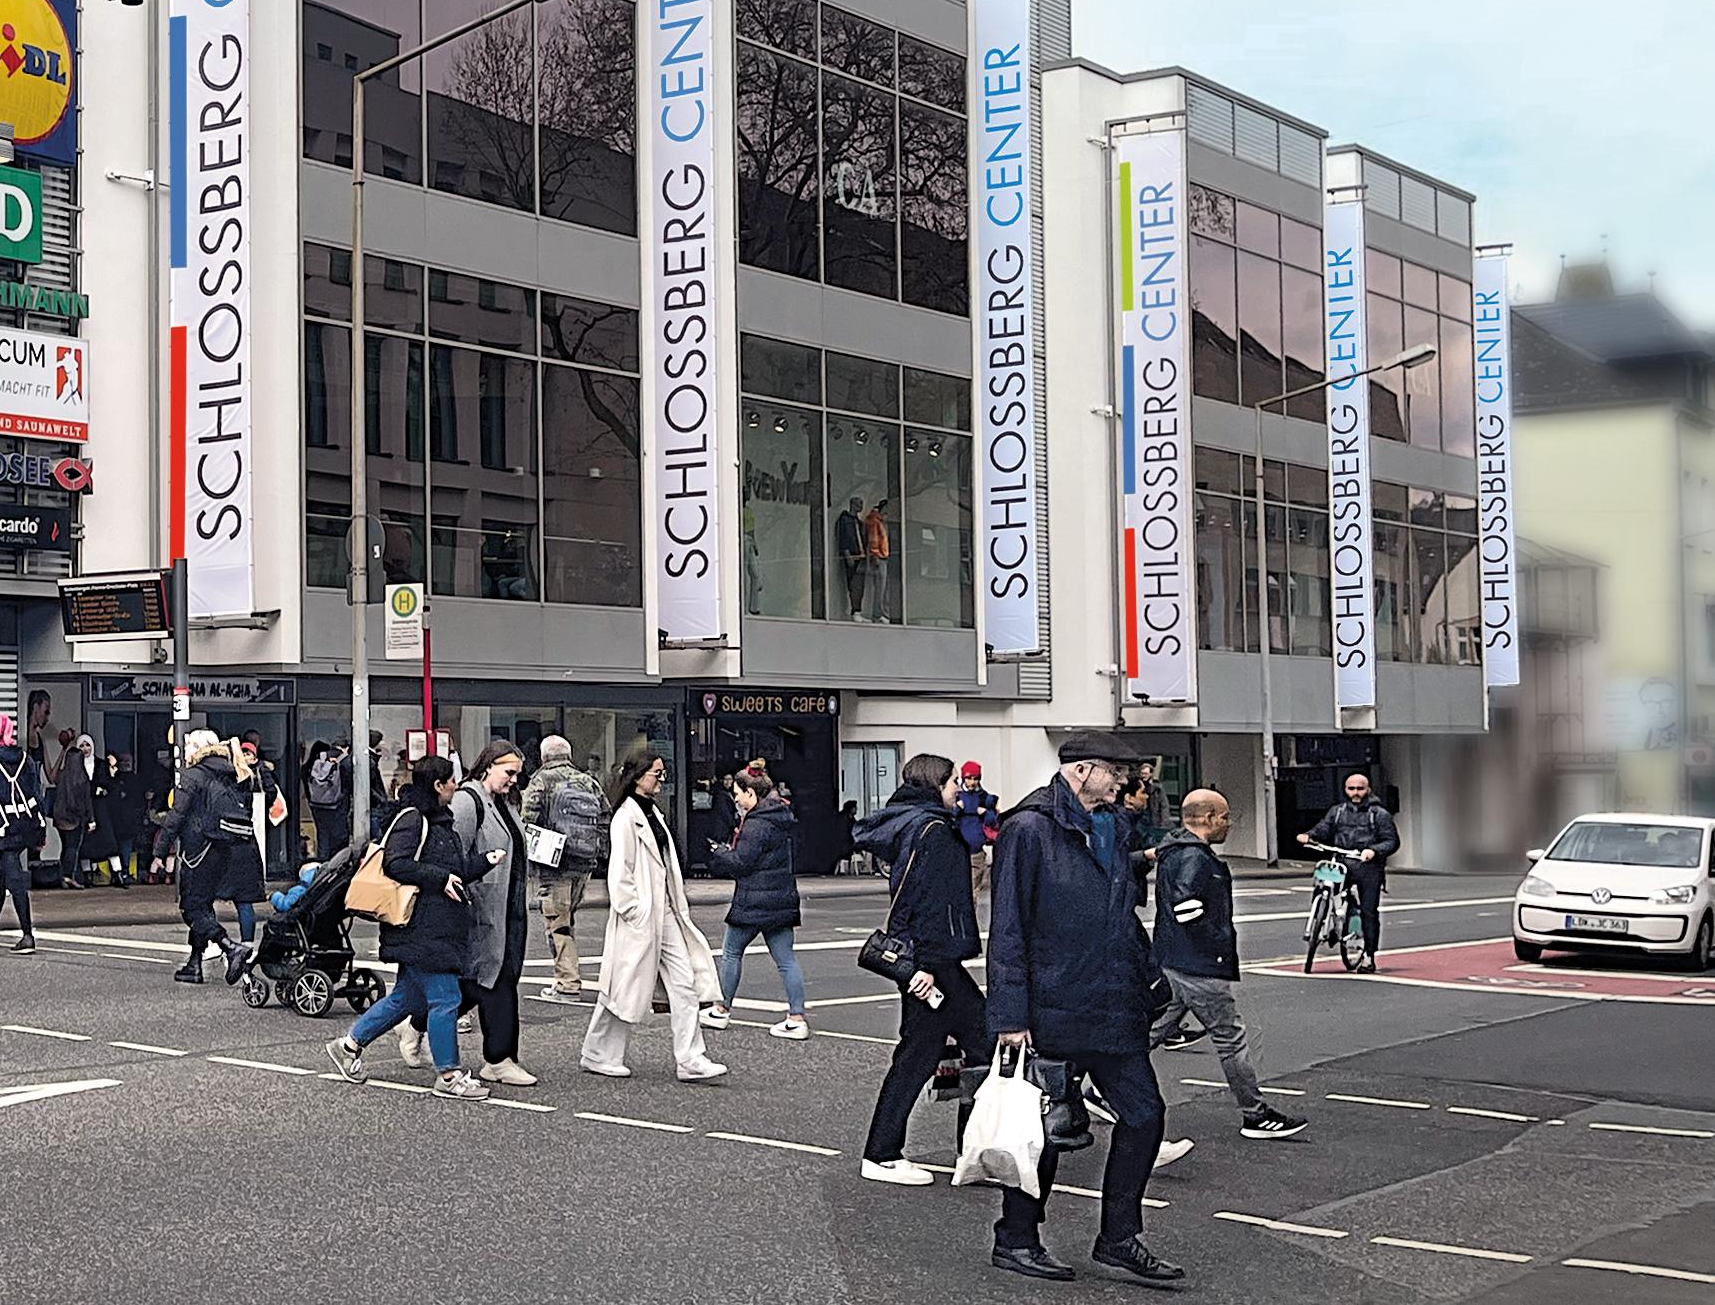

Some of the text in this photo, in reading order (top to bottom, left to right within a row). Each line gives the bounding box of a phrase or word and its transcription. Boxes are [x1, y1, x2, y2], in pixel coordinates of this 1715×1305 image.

[983, 43, 1023, 229] CENTER
[197, 34, 243, 541] SCHLOSSBERG
[663, 164, 708, 579] SCHLOSSBERG
[1140, 182, 1175, 342] CENTER
[17, 421, 82, 437] SAUNAWELT
[35, 384, 51, 399] FIT
[987, 245, 1028, 599] SCHLOSSBERG
[1143, 357, 1181, 656] SCHLOSSBERG
[1332, 404, 1365, 669] SCHLOSSBERG
[1480, 414, 1511, 649] SCHLOSSBERG
